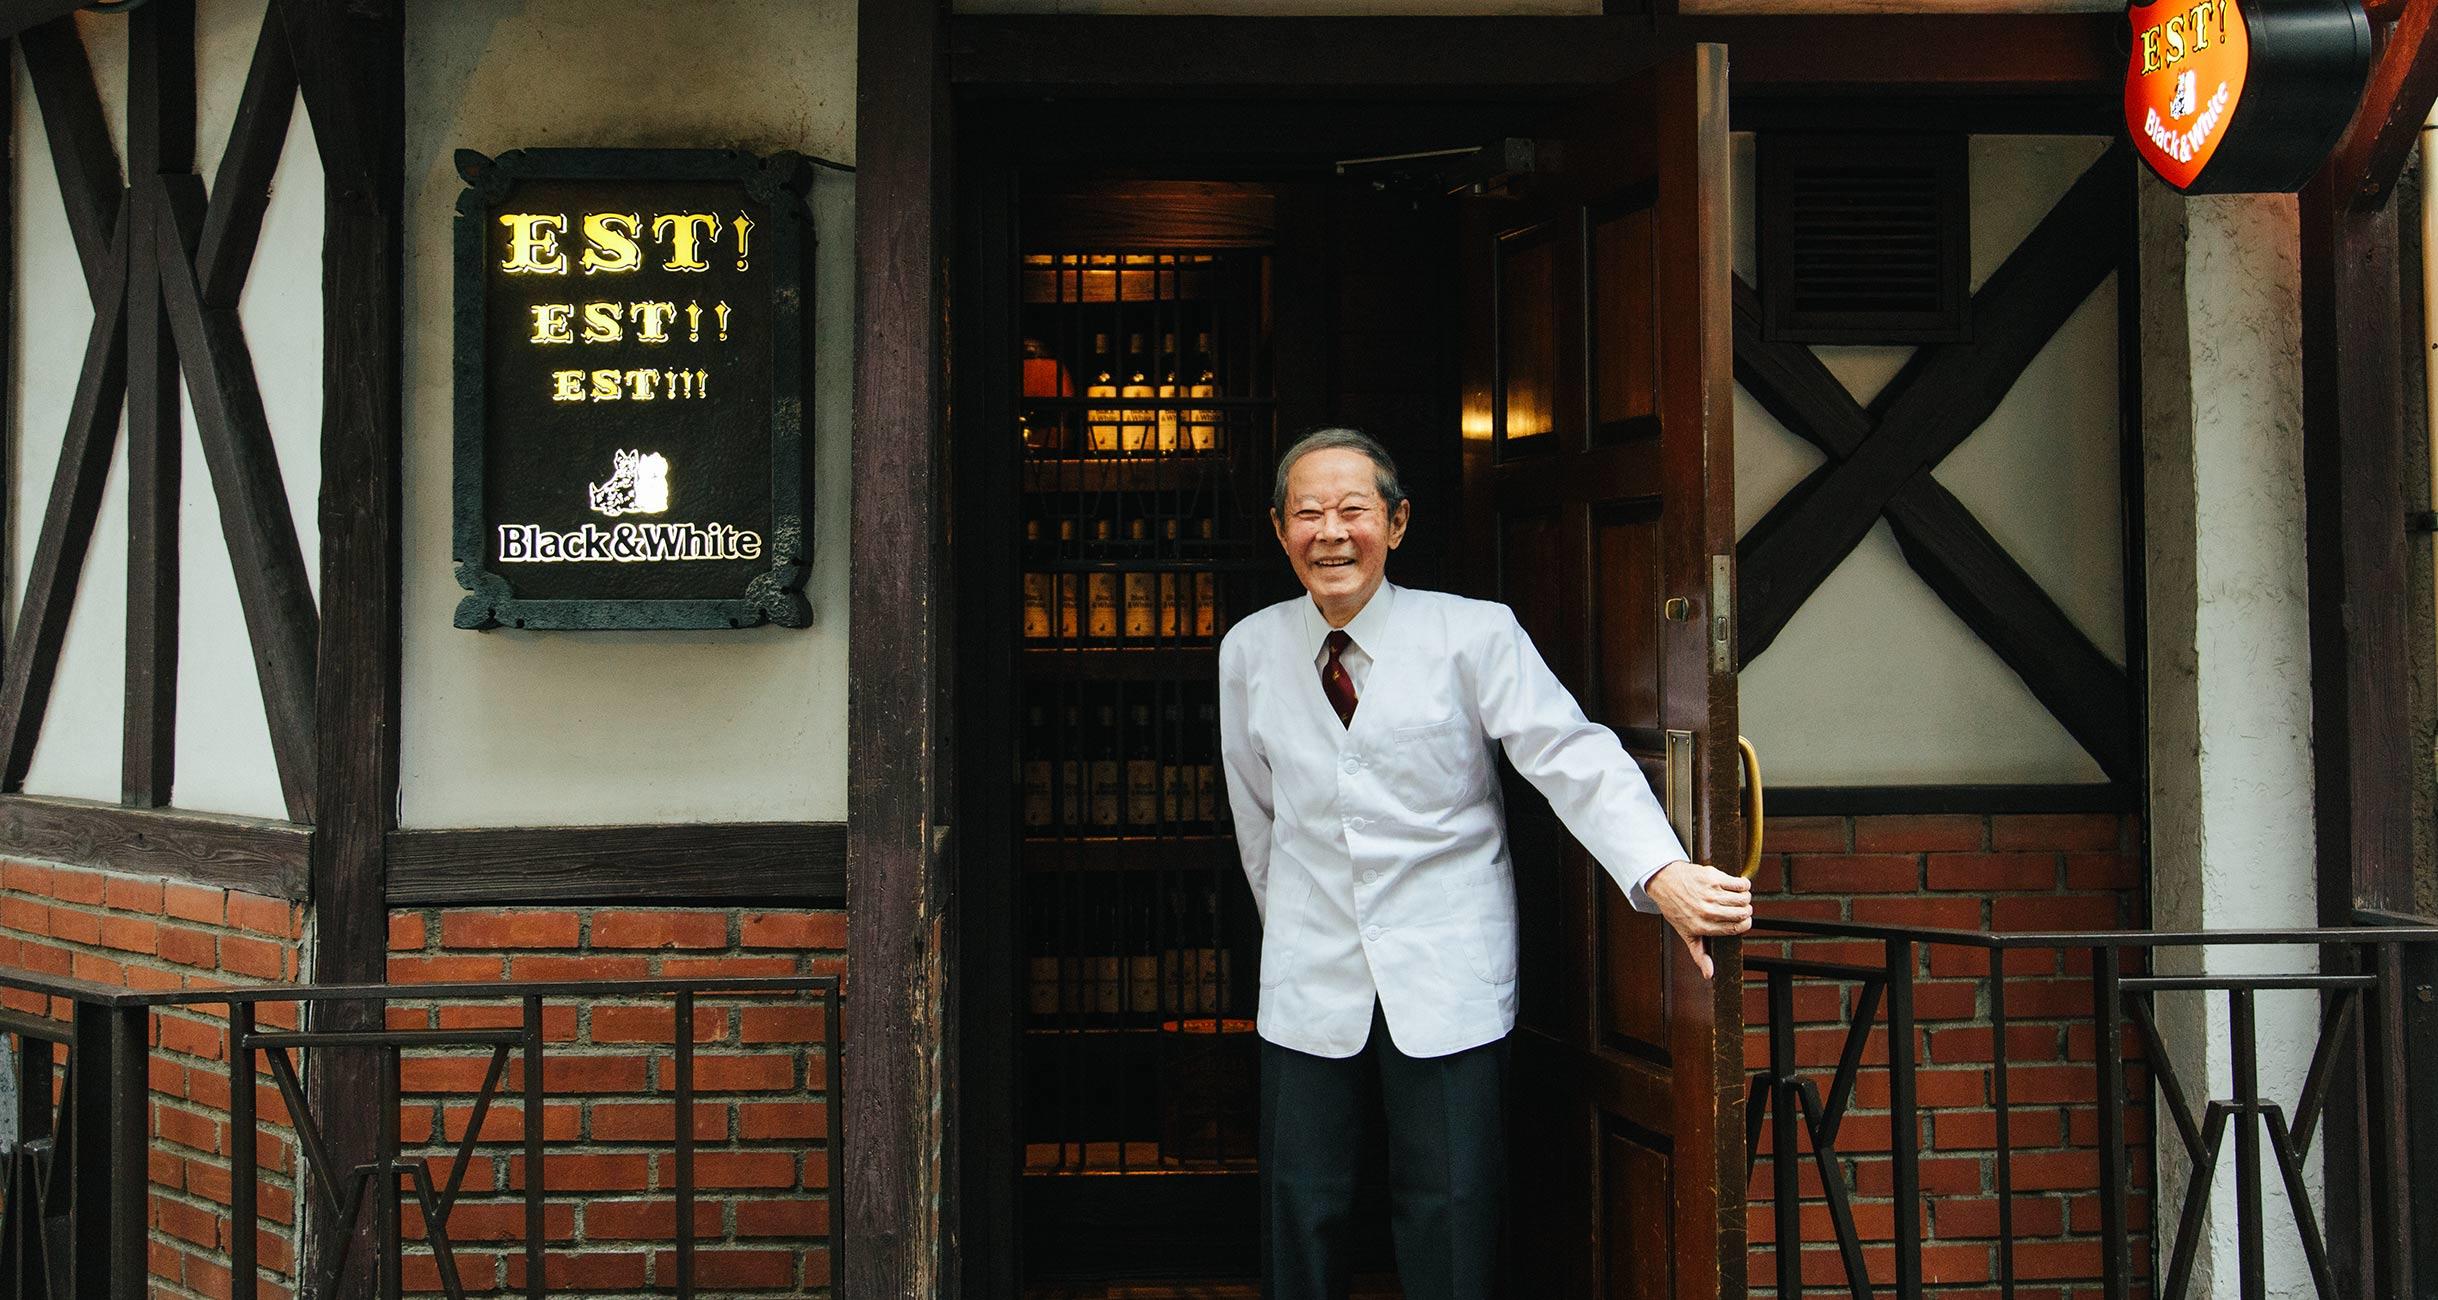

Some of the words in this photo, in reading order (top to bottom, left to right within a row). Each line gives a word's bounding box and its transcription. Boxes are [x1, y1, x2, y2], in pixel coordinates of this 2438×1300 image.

[2141, 0, 2227, 76] EST!
[2144, 81, 2229, 164] Black&White
[499, 209, 754, 275] EST!
[530, 299, 731, 344] EST!!
[551, 366, 708, 401] EST!!!
[498, 523, 762, 562] Black&White
